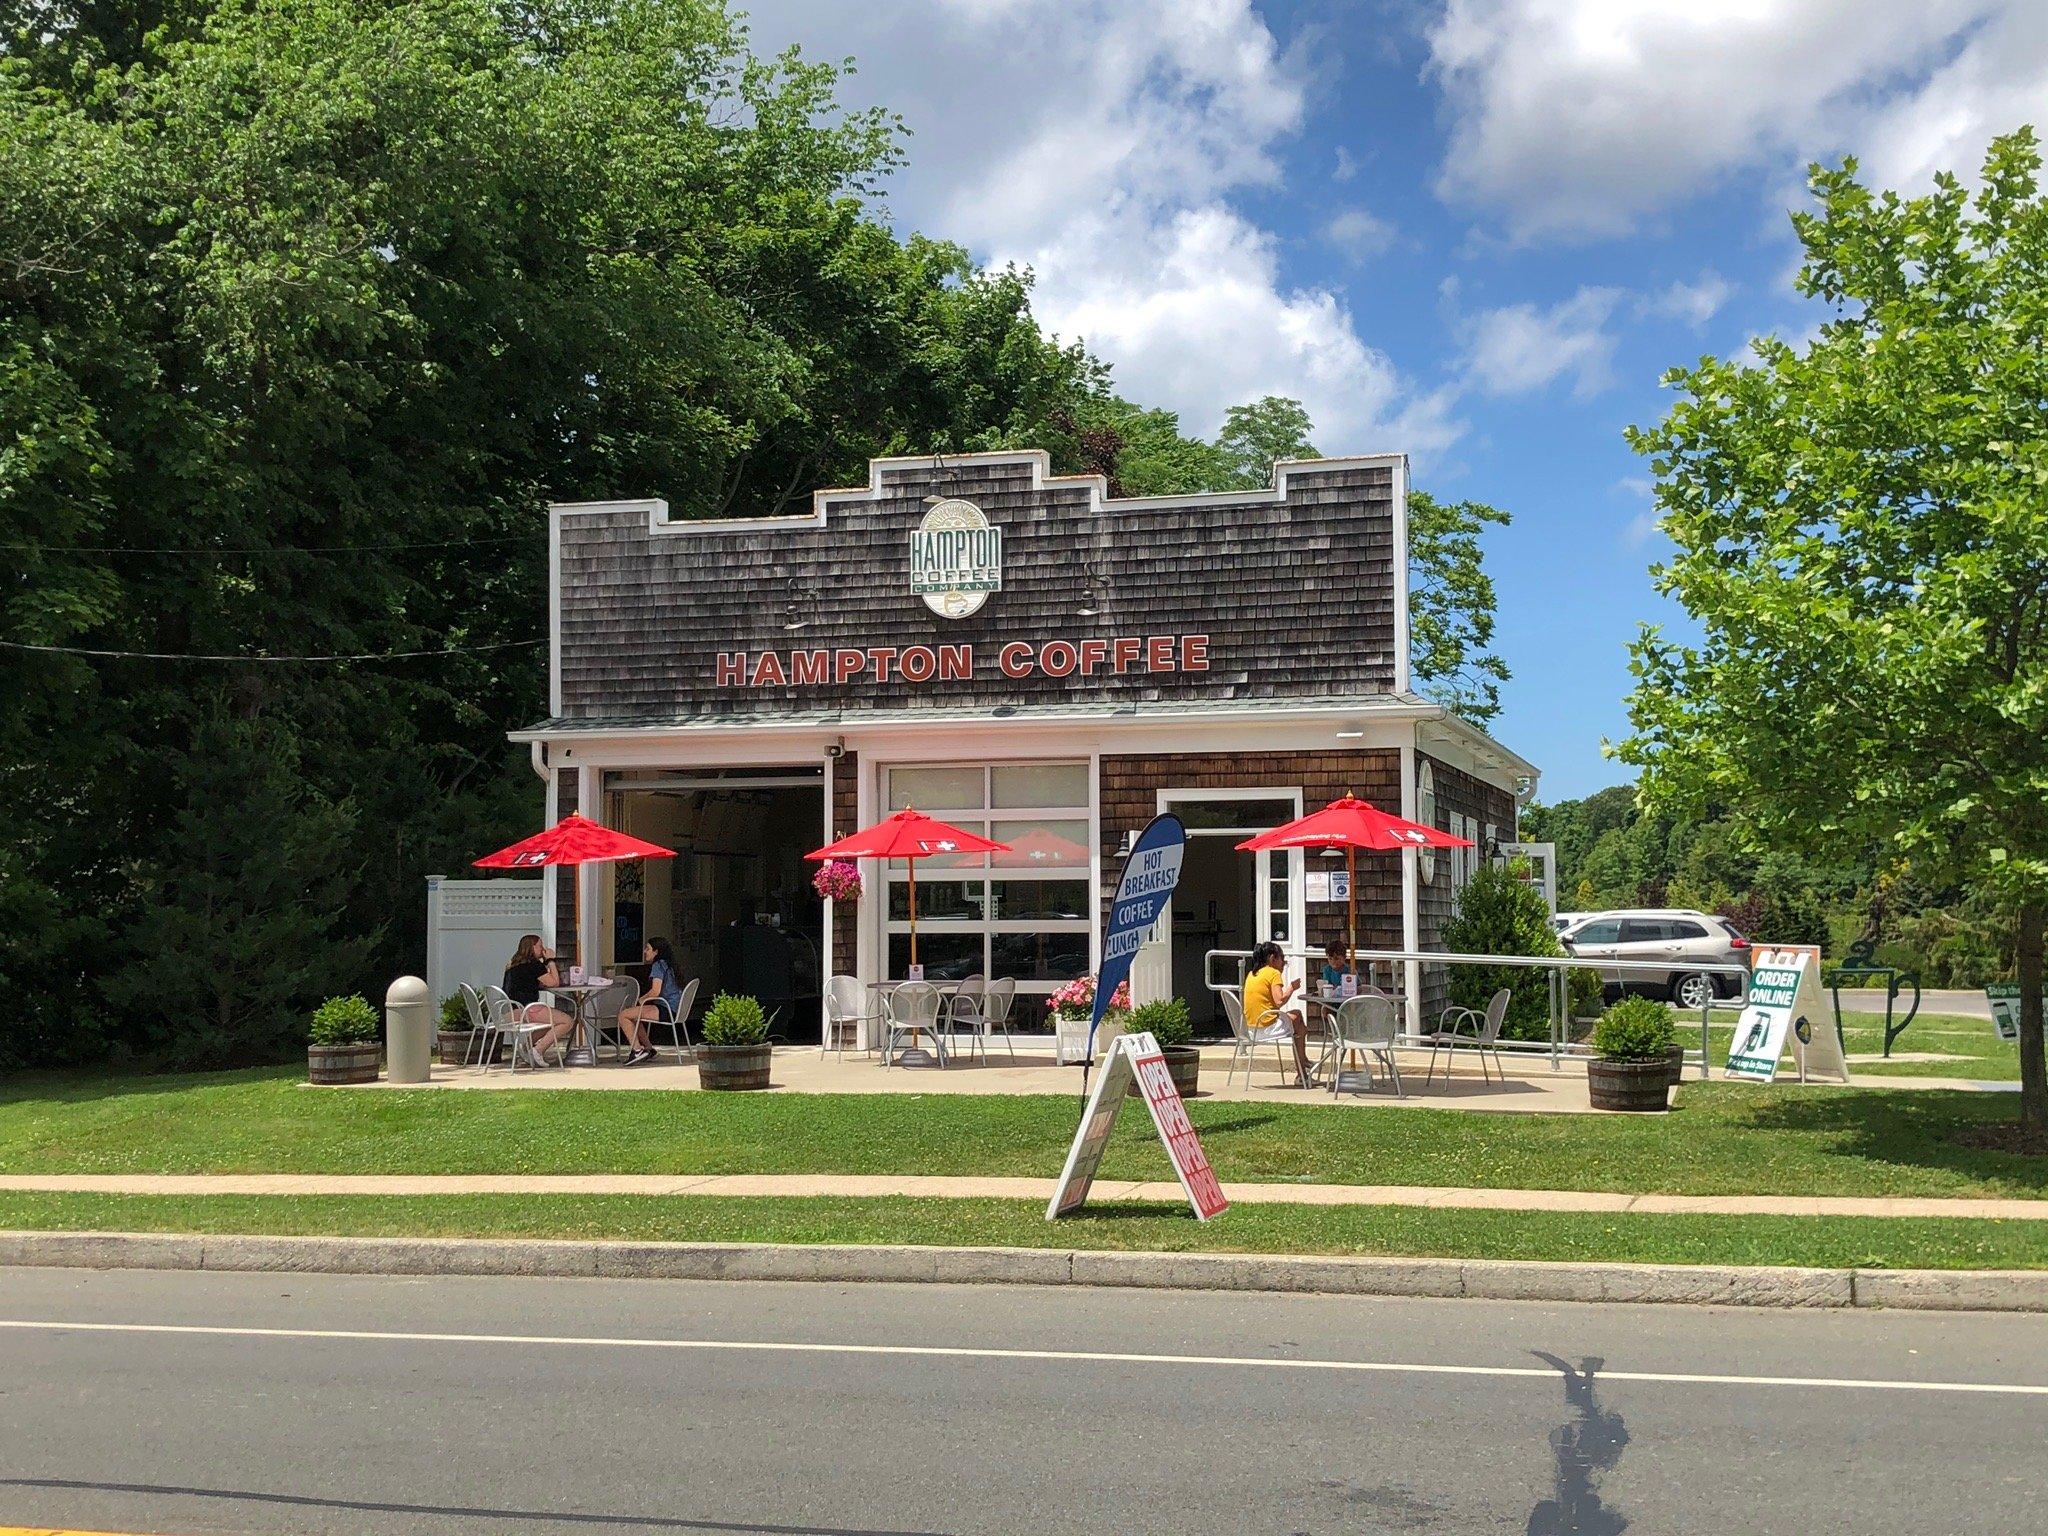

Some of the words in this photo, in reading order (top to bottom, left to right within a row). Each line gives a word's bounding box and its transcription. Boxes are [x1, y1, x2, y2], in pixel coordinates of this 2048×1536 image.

[911, 529, 999, 571] HAMPTON
[911, 569, 999, 583] COFFEE
[914, 582, 995, 593] COMPANY
[715, 644, 973, 687] HAMPTON
[999, 635, 1210, 678] COFFEE
[1144, 851, 1163, 871] HOT
[1126, 868, 1176, 895] BREAKFAST
[1119, 900, 1154, 925] COFFEE
[1107, 930, 1139, 957] LUNCH
[1755, 971, 1797, 988] ORDER
[1749, 987, 1793, 1006] ONLINE
[1139, 1059, 1179, 1101] OPEN
[1756, 1061, 1773, 1072] Store
[1155, 1095, 1194, 1138] OPEN
[1172, 1131, 1210, 1175] OPEN
[1188, 1168, 1227, 1212] OPEN
